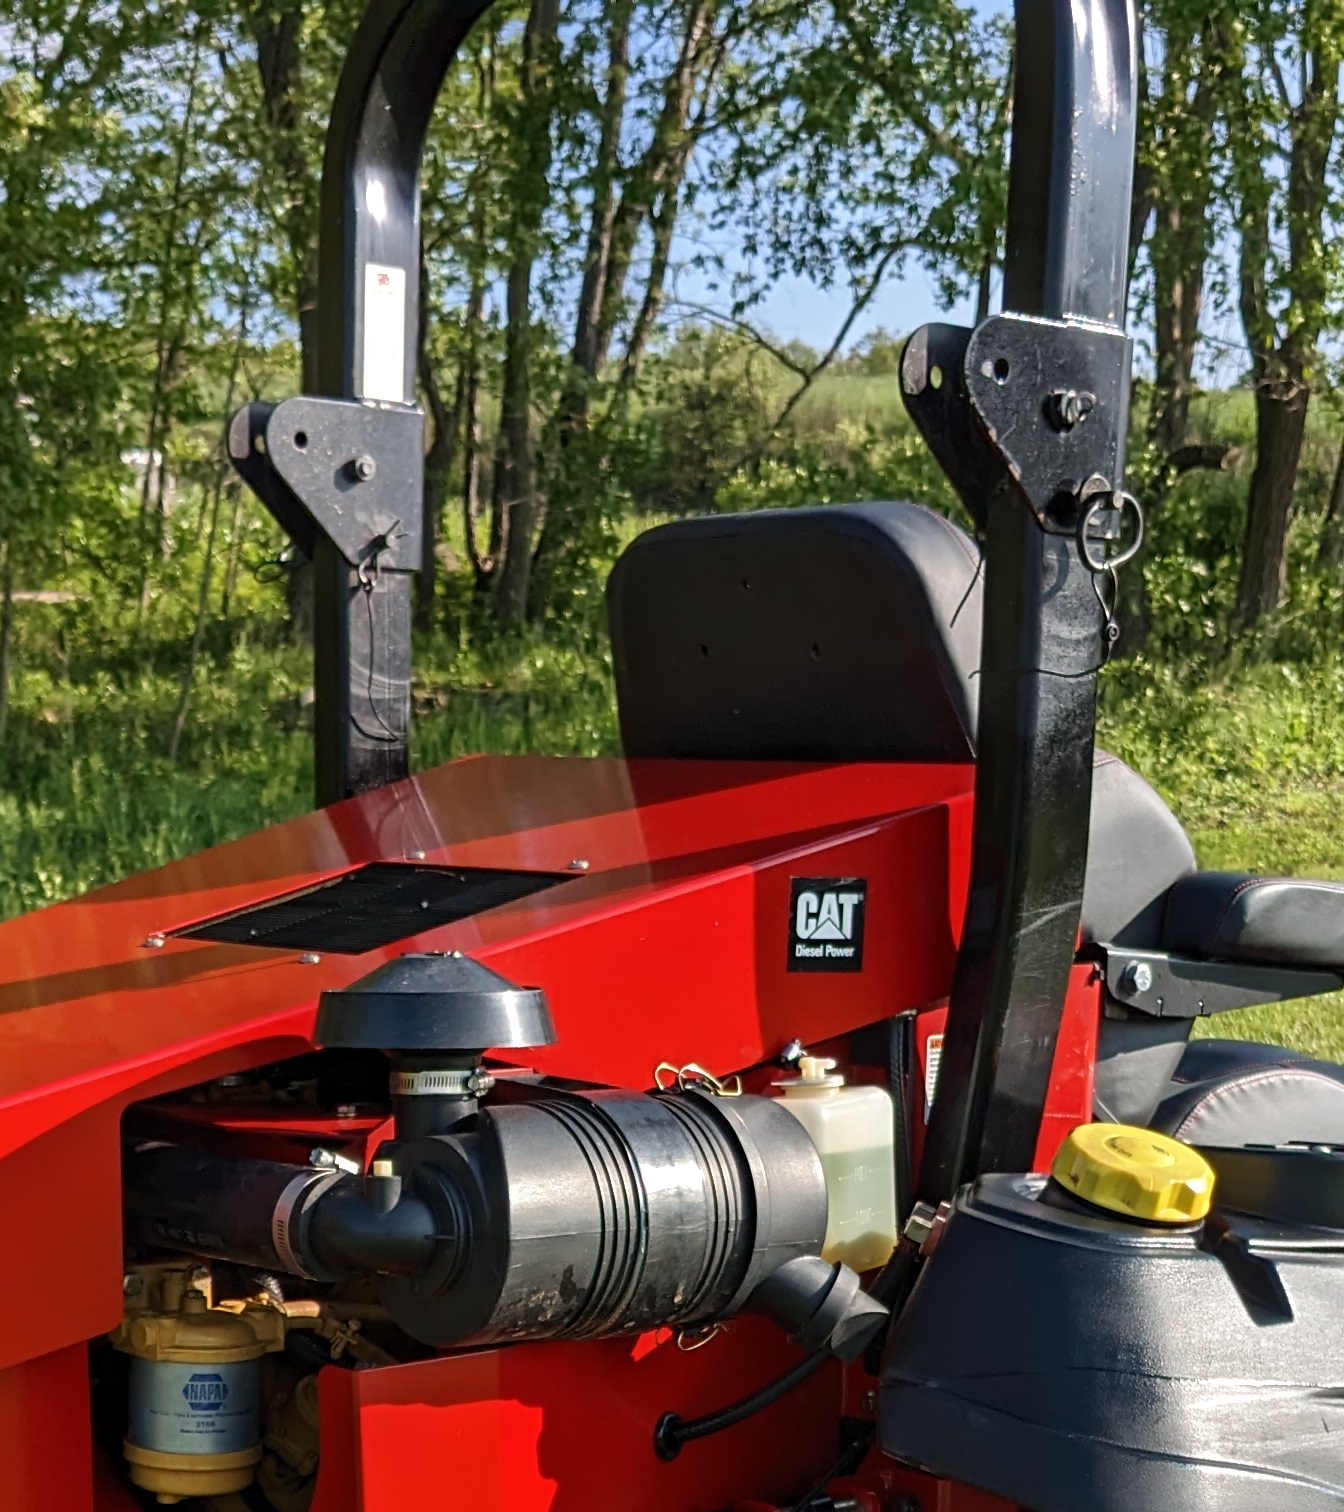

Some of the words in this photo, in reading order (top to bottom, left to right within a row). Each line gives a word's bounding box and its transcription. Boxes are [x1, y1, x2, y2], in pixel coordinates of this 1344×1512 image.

[796, 892, 858, 940] CAT
[795, 944, 824, 958] Diesel
[825, 945, 855, 958] Power
[189, 1383, 222, 1402] NAPA
